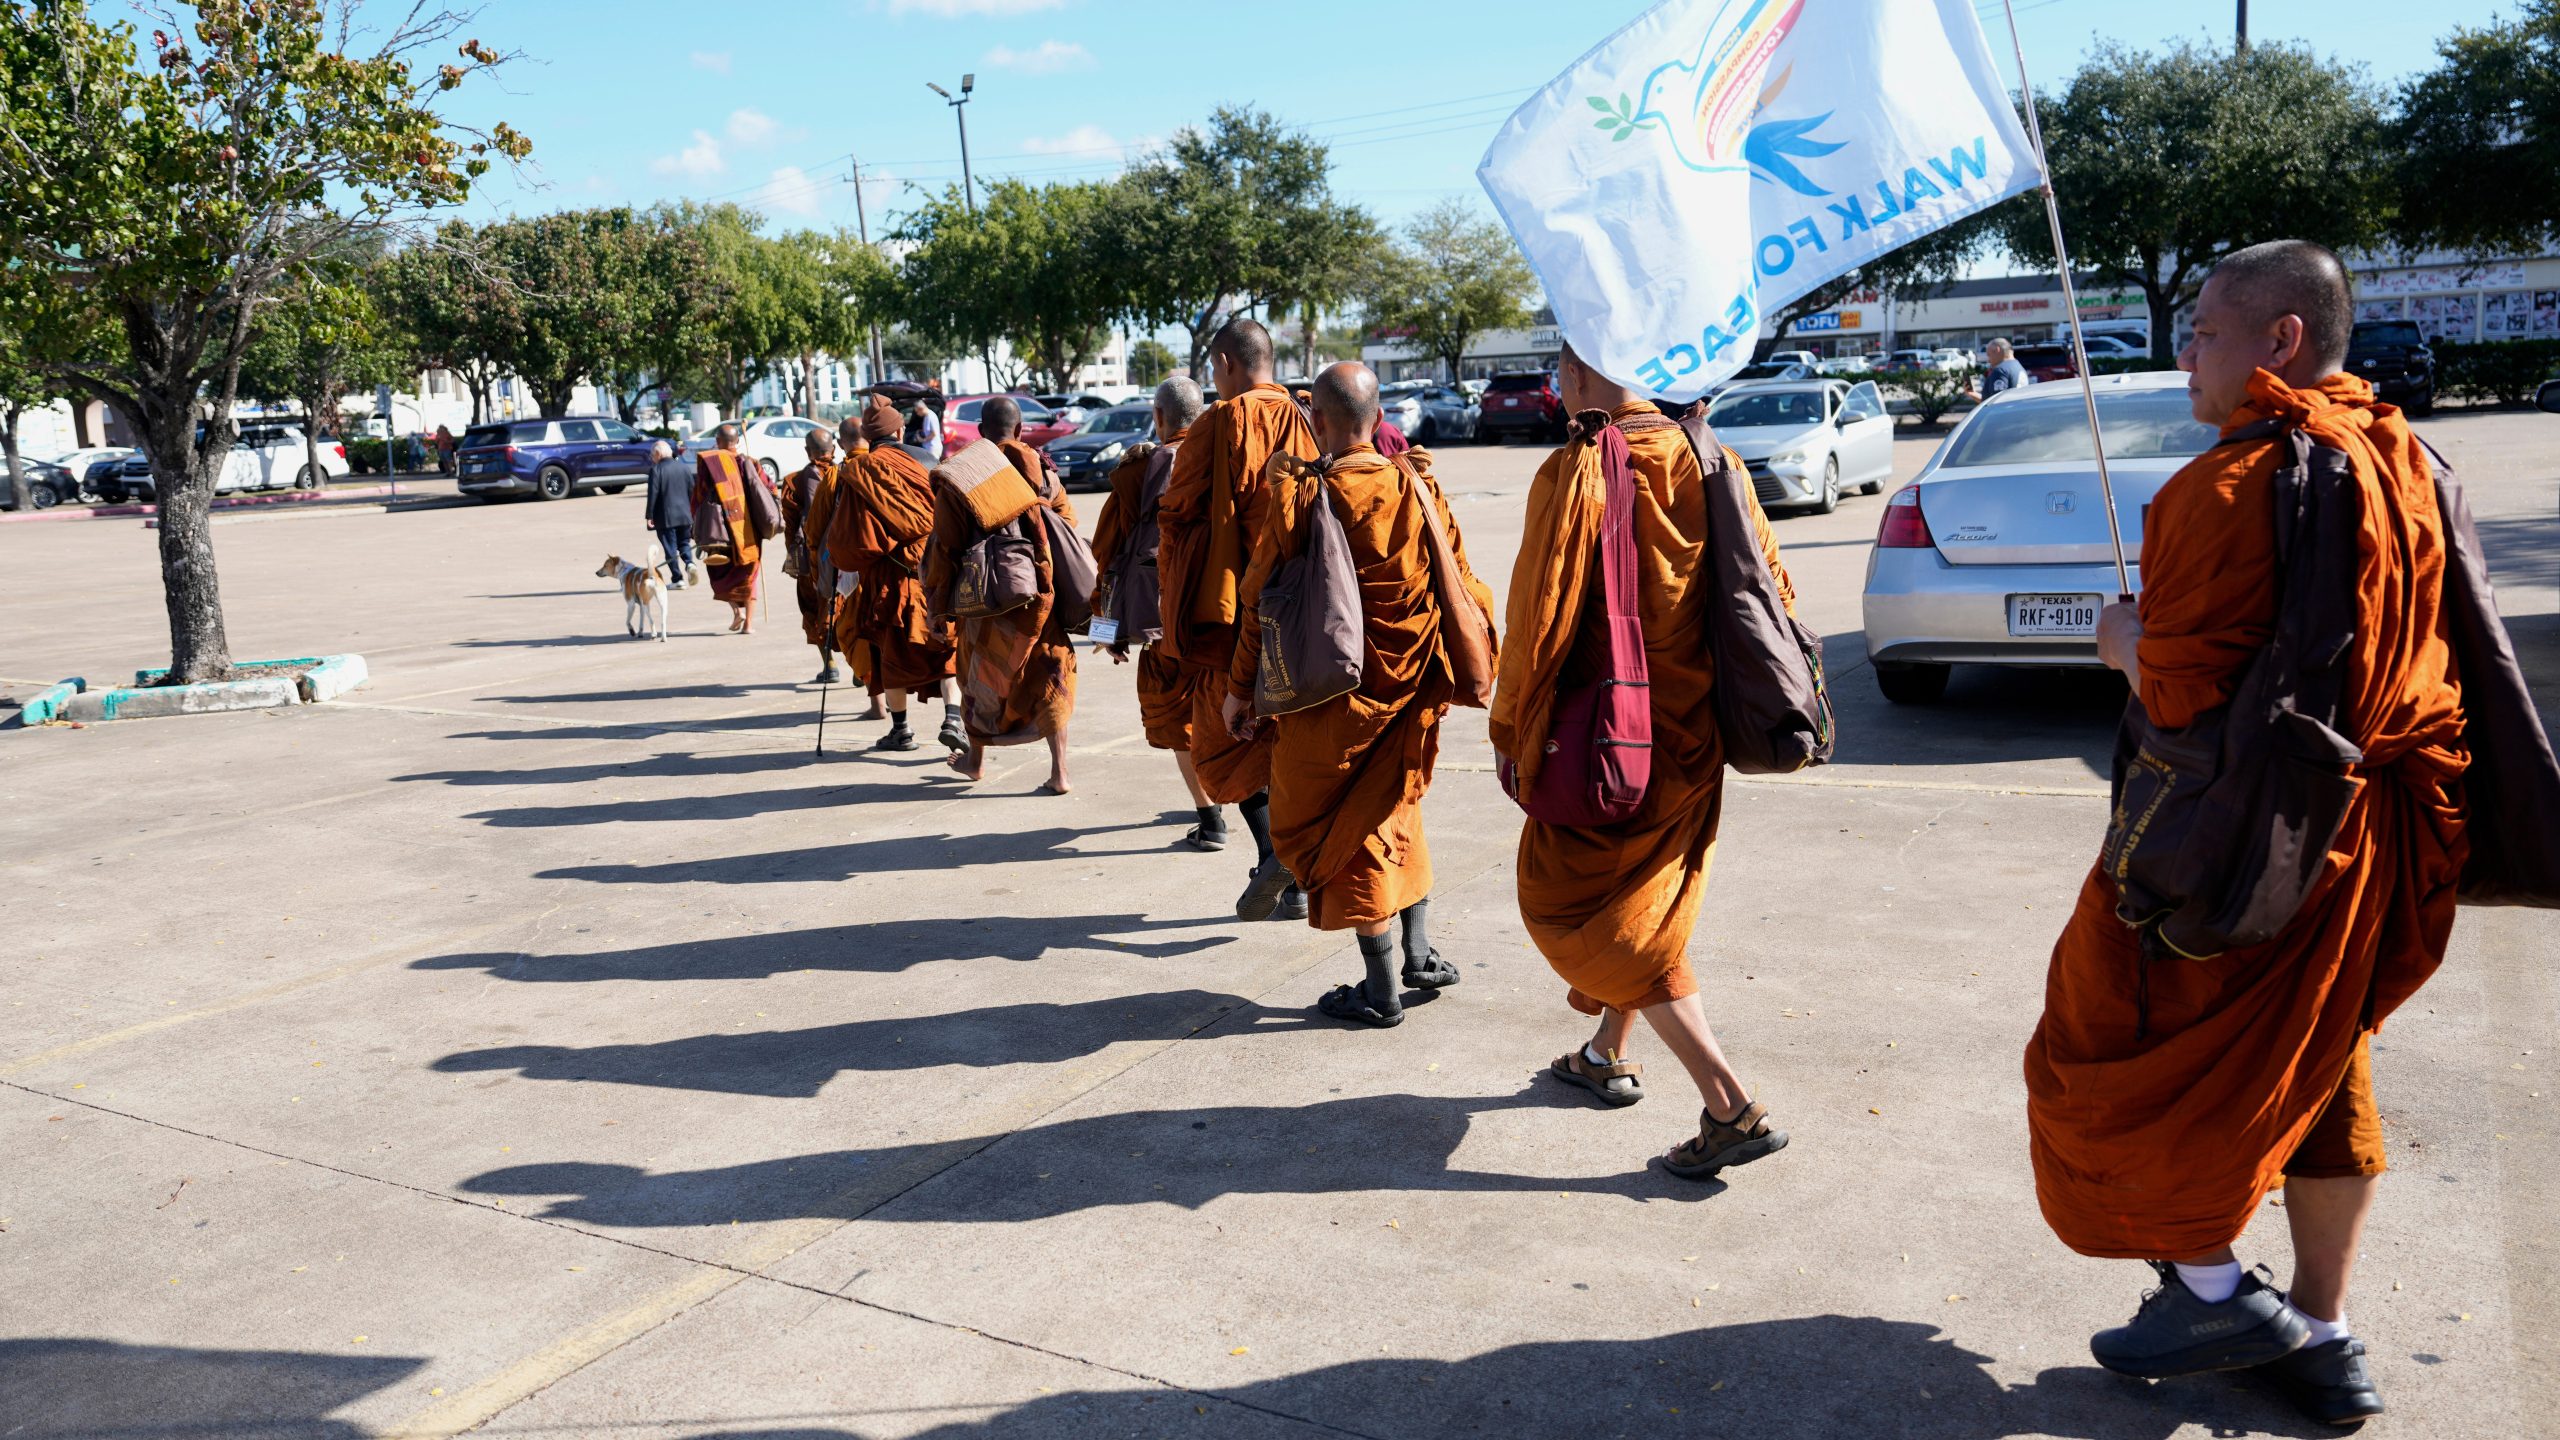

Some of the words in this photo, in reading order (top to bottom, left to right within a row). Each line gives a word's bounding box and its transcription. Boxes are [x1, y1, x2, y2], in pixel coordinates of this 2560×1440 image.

[1798, 316, 1839, 329] TOFU
[1944, 533, 1998, 541] Accord
[2041, 597, 2072, 605] TEXAS
[2019, 608, 2047, 626] RKF
[2055, 608, 2093, 626] 9109
[2133, 770, 2177, 835] SCRIPTURE
